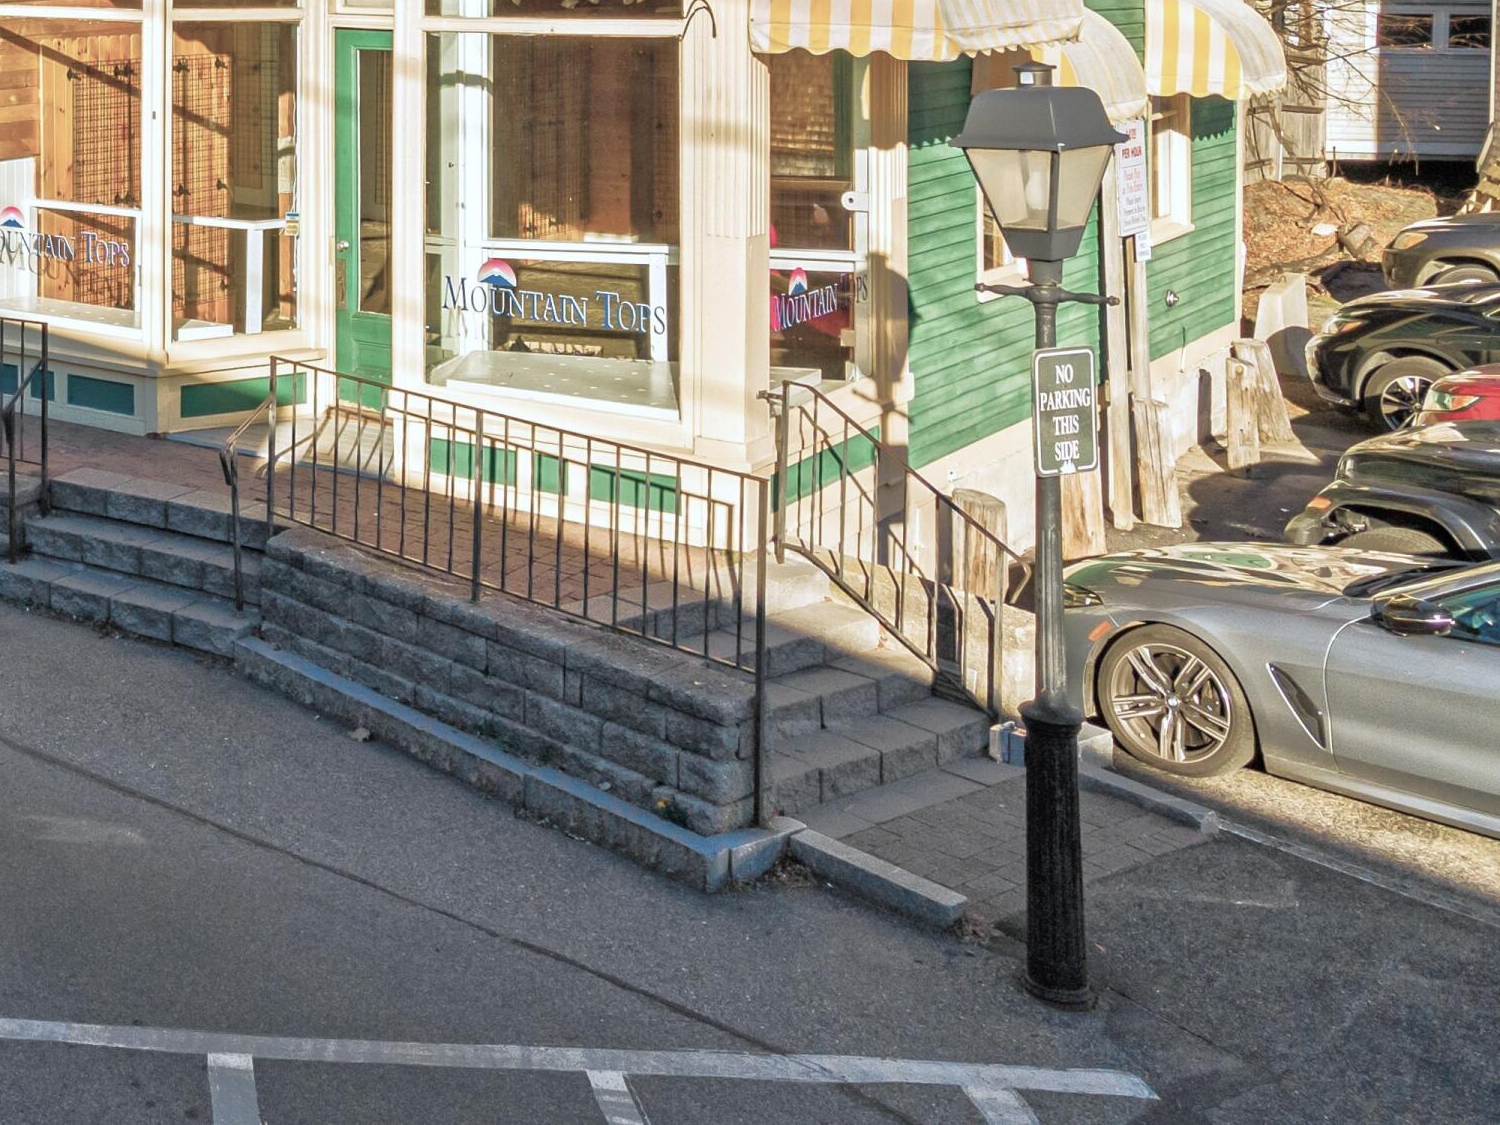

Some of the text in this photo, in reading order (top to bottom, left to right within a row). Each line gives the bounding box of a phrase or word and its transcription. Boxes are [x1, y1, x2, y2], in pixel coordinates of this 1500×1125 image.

[81, 230, 130, 268] TOPS
[442, 275, 666, 335] MOUNTAIN TOPS
[771, 282, 839, 332] MOUNTAIN
[1055, 363, 1073, 384] NO
[1040, 387, 1091, 412] PARKING
[1052, 415, 1079, 436] THIS
[1054, 440, 1080, 461] SIDE
